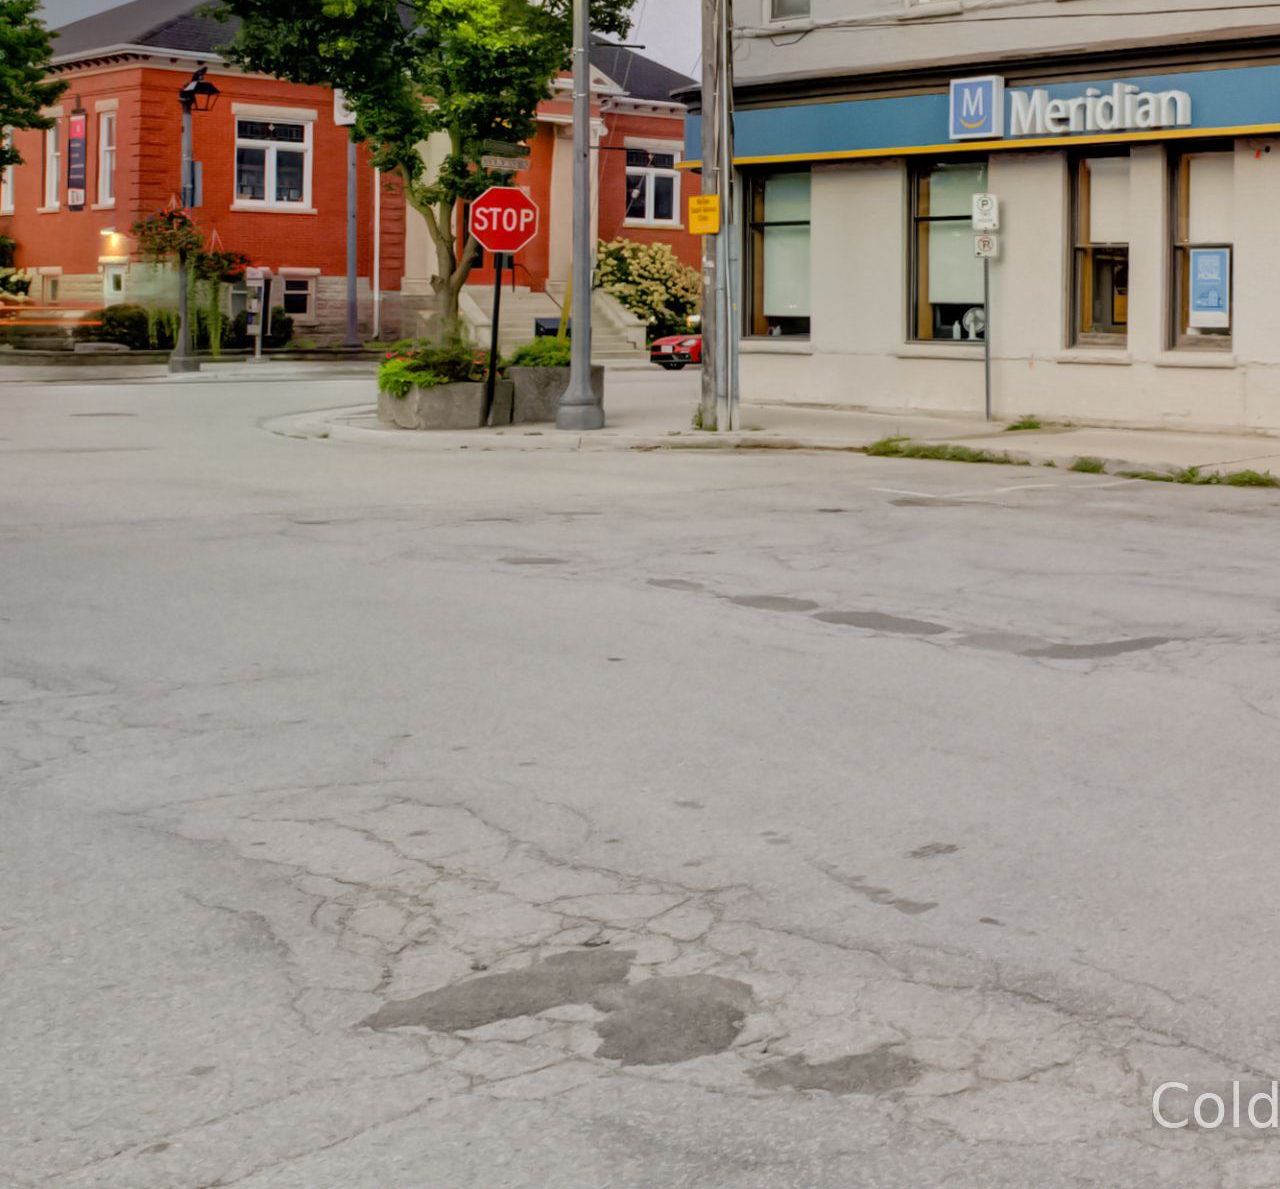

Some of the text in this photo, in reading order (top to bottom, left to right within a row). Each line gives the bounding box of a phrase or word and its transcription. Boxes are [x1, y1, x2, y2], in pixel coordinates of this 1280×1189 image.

[963, 82, 1192, 135] M Meridian
[474, 206, 534, 232] STOP
